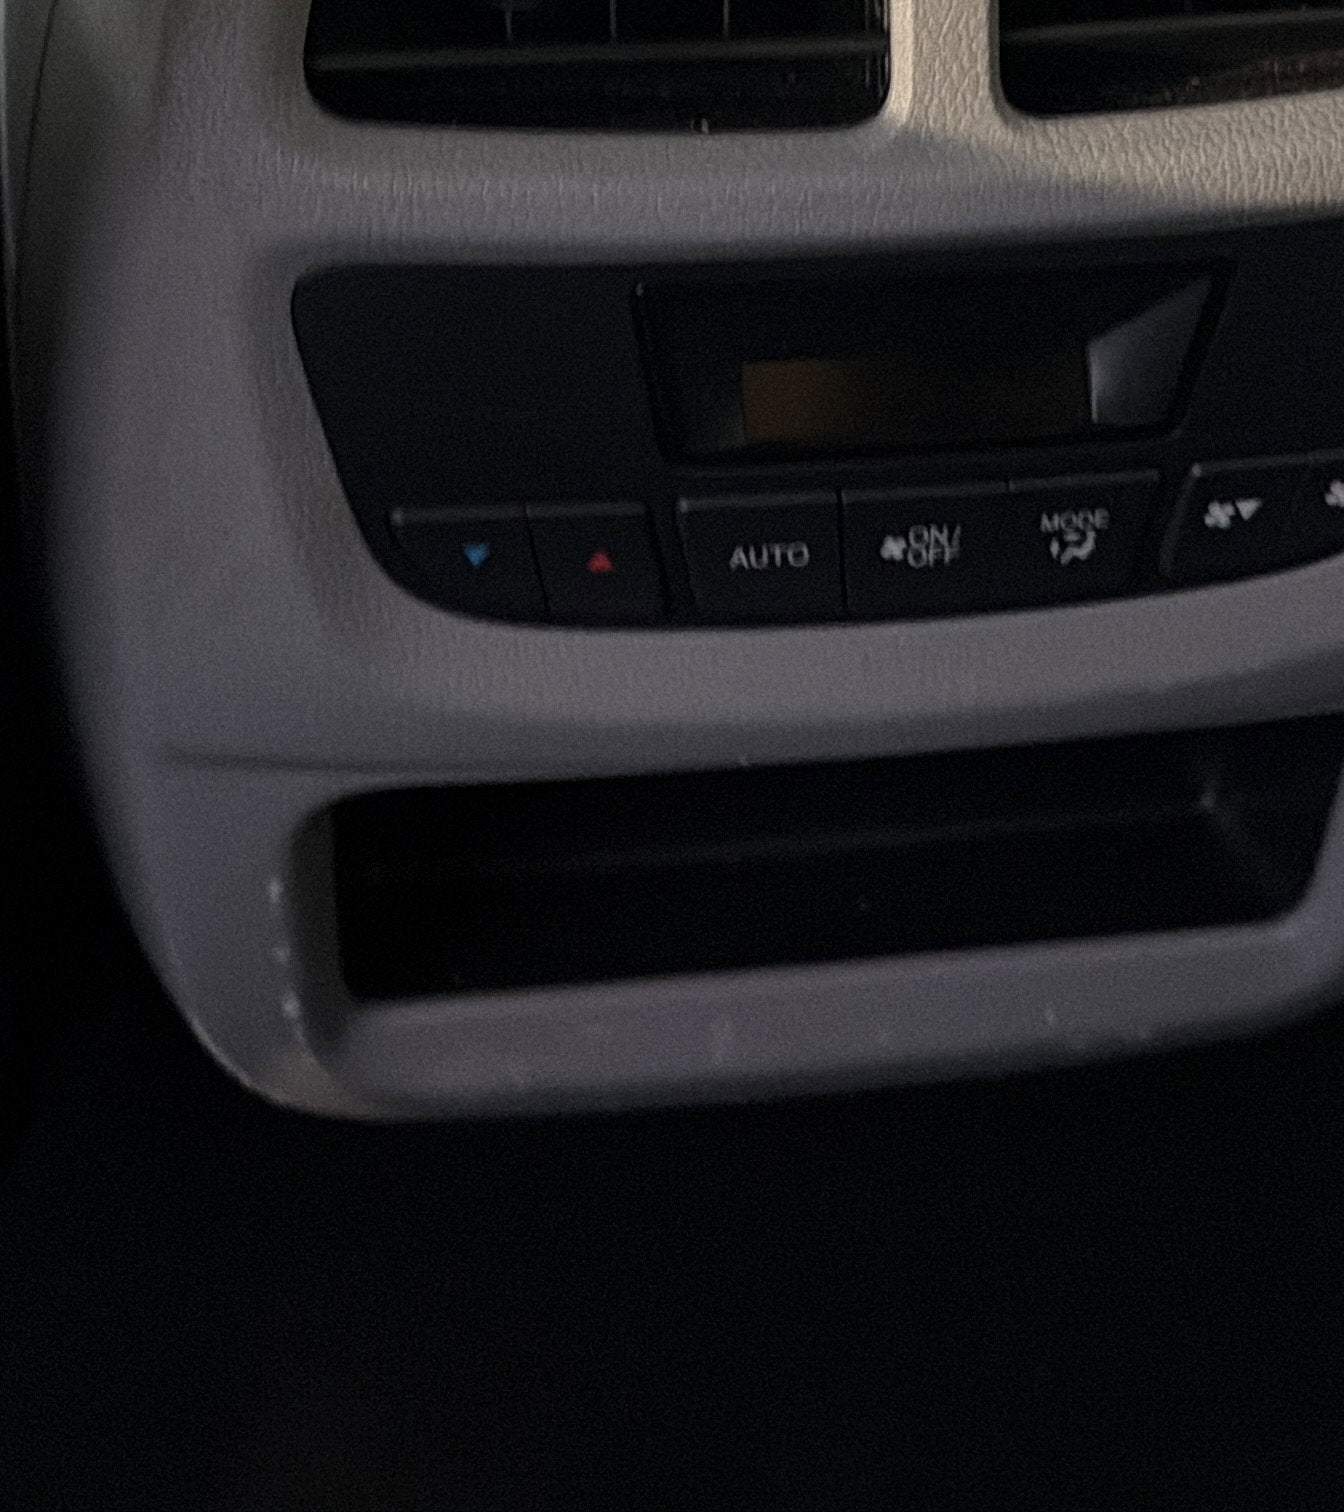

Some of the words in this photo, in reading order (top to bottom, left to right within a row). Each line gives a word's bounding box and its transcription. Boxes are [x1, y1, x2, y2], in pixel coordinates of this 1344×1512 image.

[1040, 508, 1109, 532] MODE
[729, 541, 810, 570] AUTO
[907, 546, 960, 567] OFF
